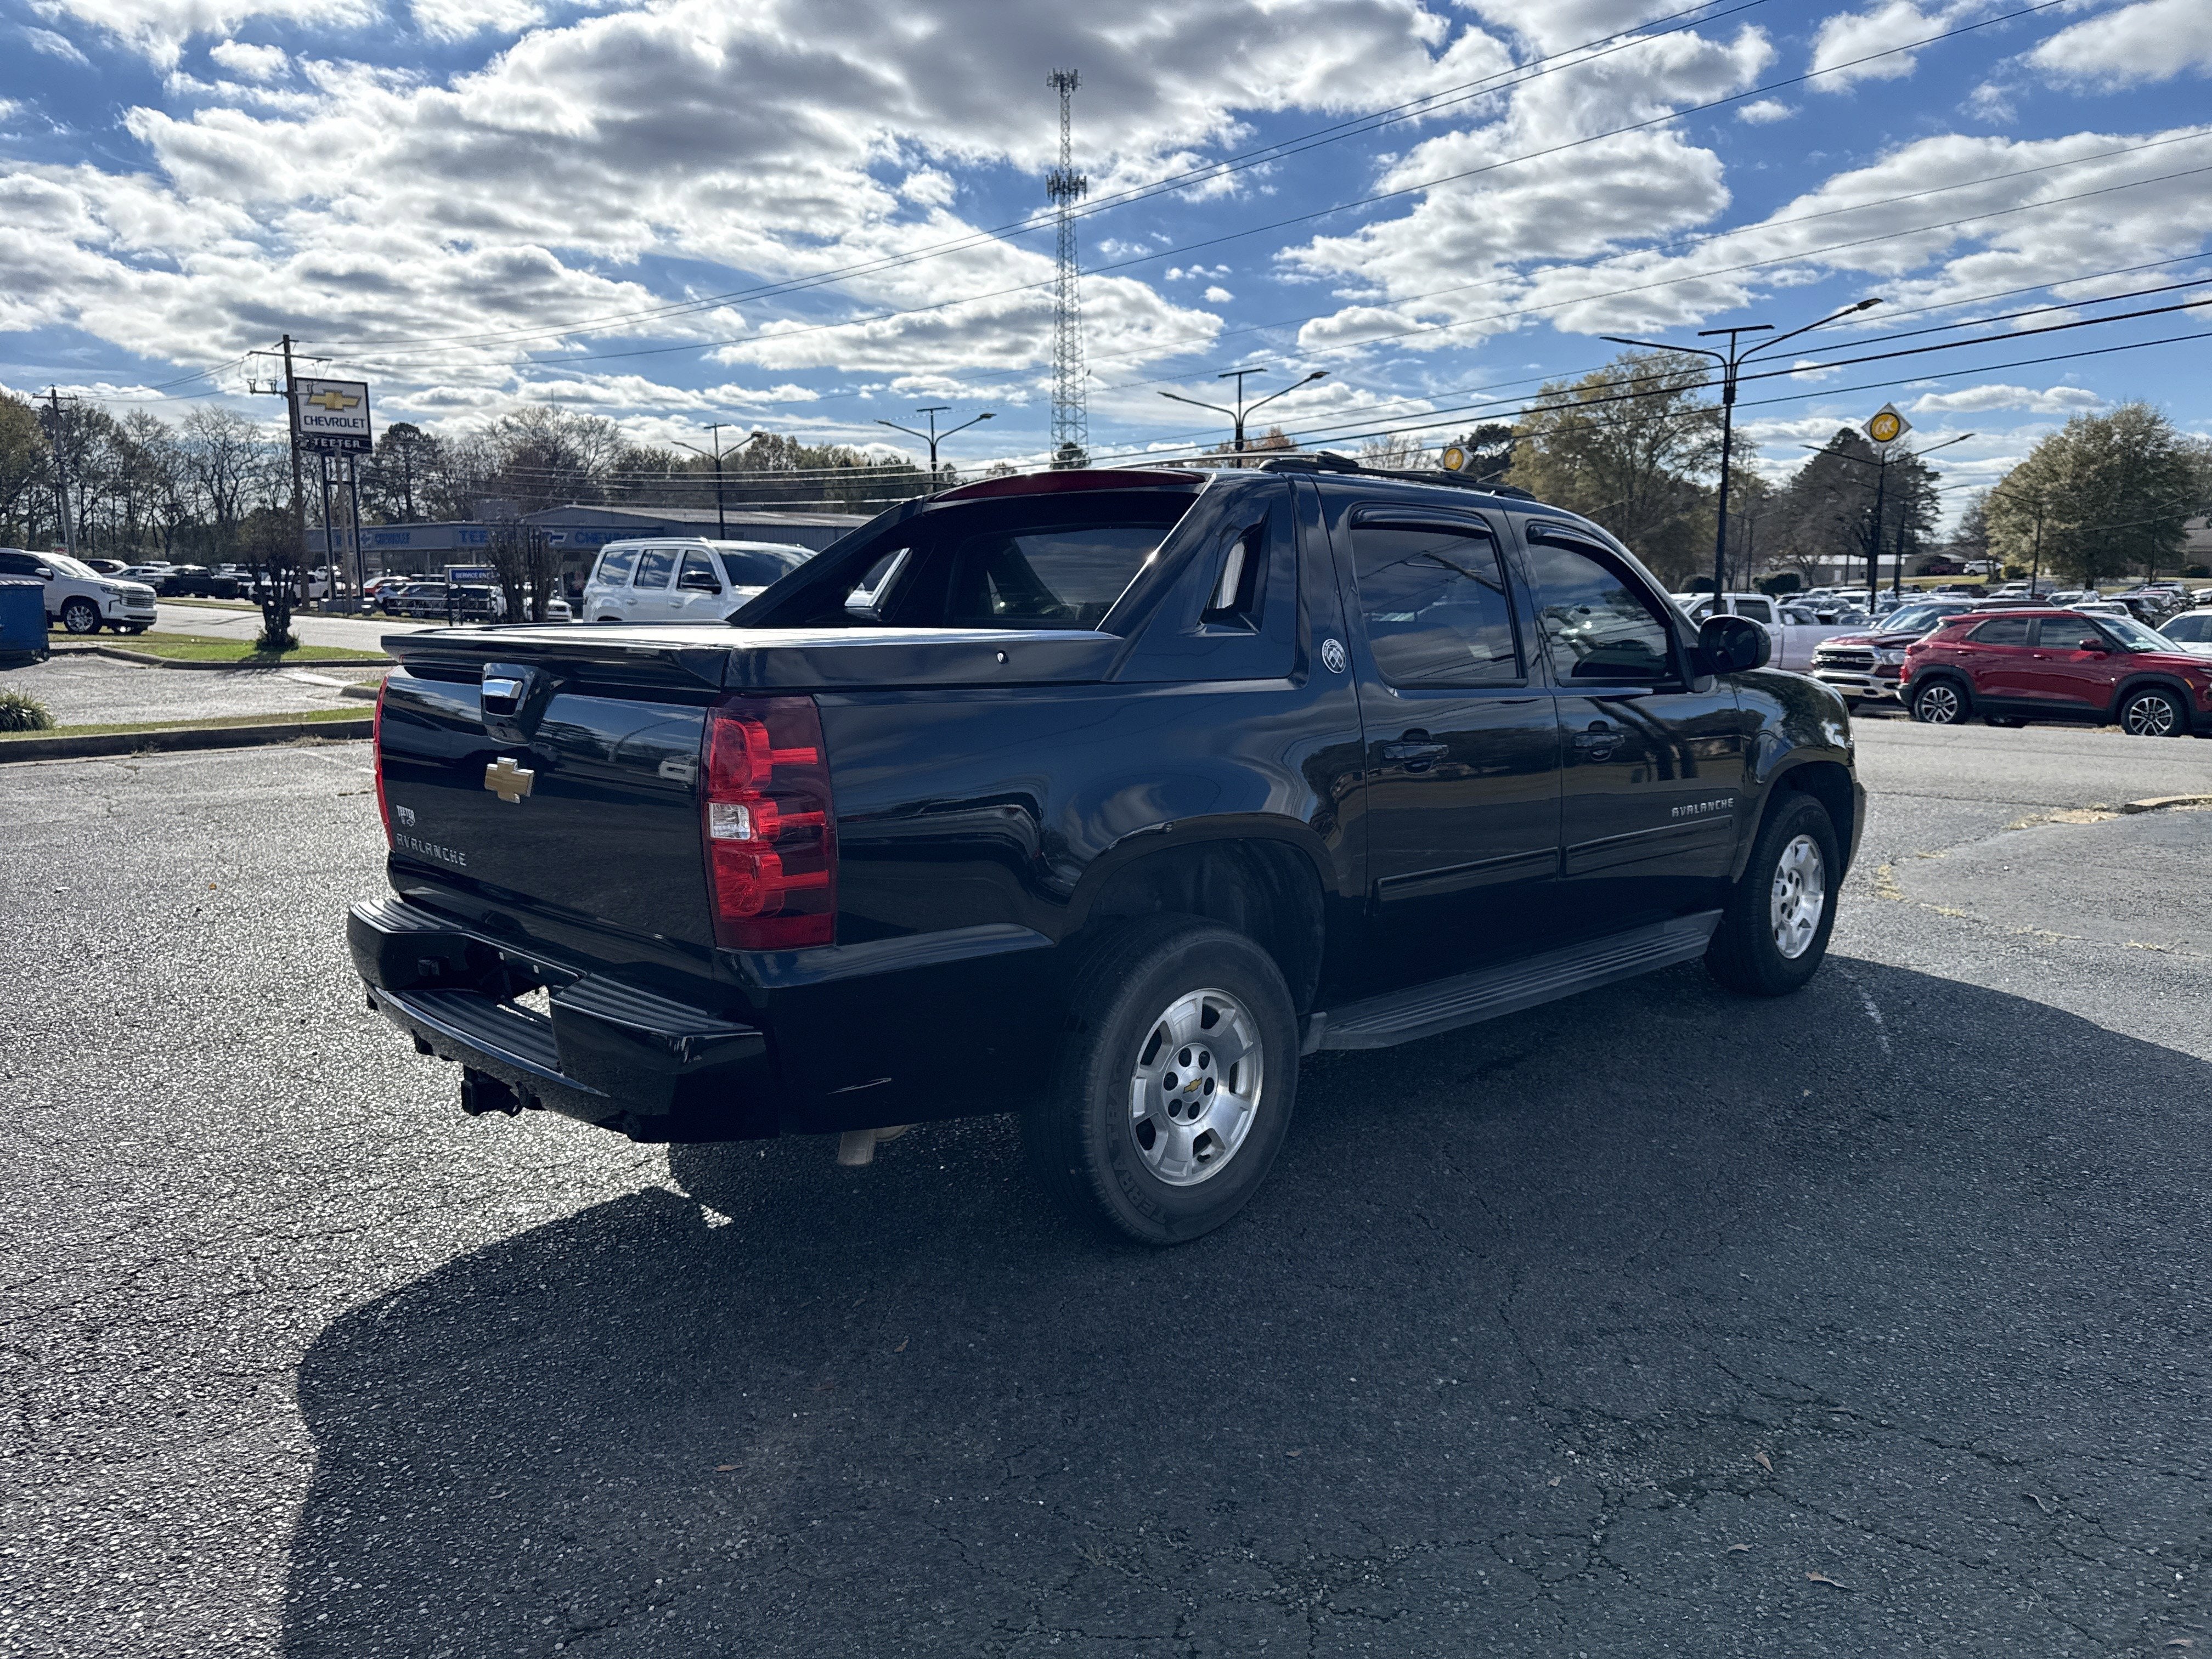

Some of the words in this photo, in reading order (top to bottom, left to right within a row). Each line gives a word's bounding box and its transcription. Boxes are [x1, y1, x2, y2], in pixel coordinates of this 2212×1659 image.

[303, 415, 365, 428] CHEVROLET
[313, 438, 360, 448] TEETER
[1672, 798, 1734, 817] AVALANCHE
[396, 833, 466, 866] AVALANCHE
